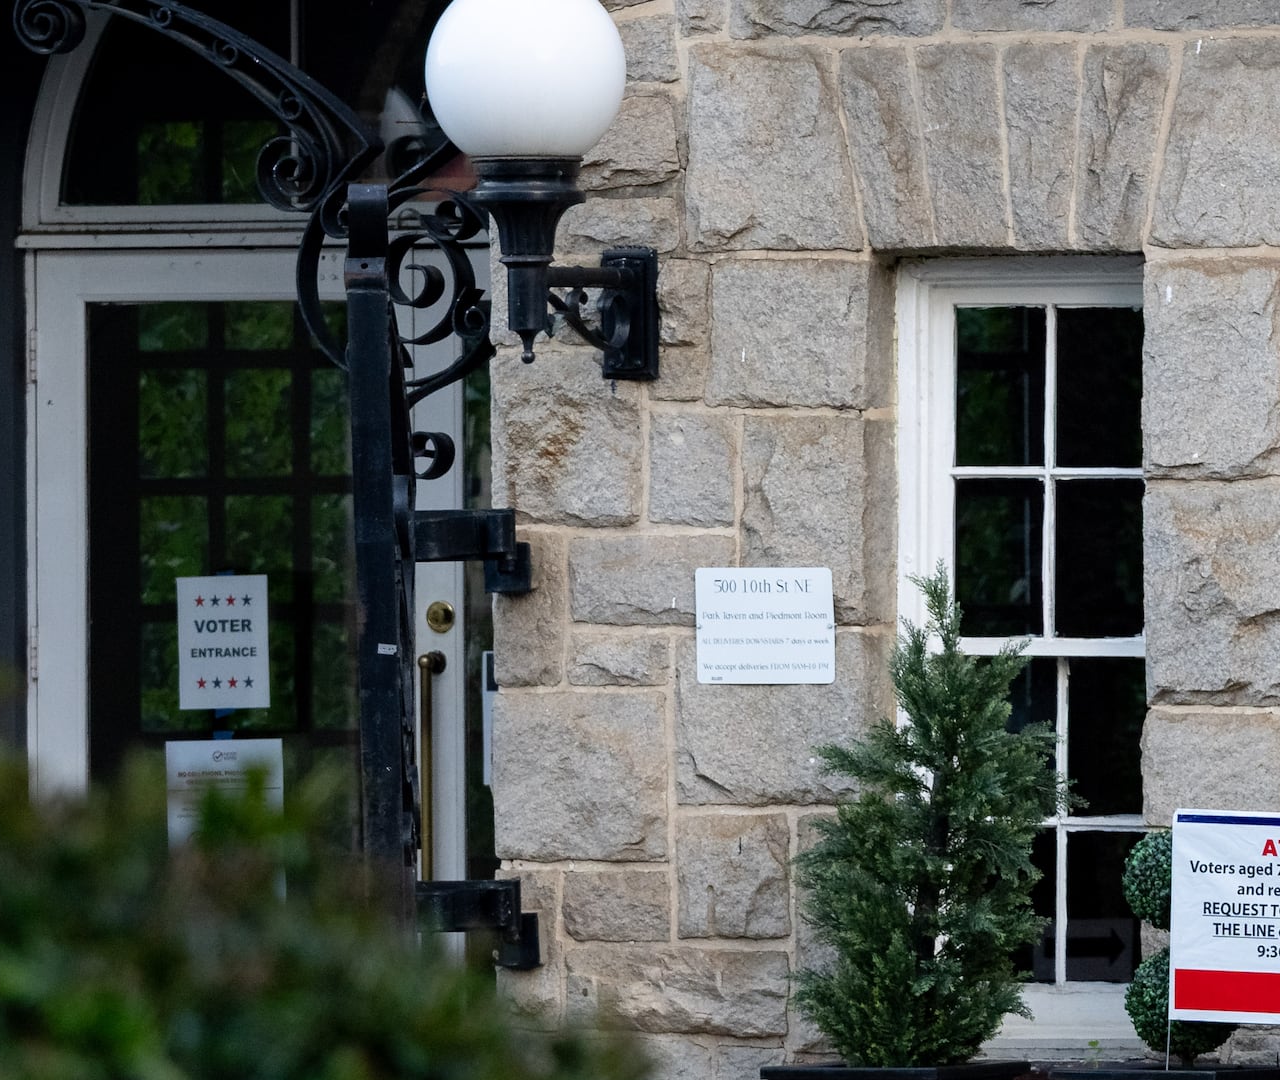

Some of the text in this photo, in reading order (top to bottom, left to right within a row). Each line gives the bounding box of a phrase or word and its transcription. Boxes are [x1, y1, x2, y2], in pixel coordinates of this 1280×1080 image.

[714, 579, 813, 593] 500 10th St NE
[702, 612, 720, 620] Park
[749, 612, 764, 620] and
[766, 612, 801, 620] Piedmont
[805, 612, 828, 620] Room
[194, 618, 253, 633] VOTER
[190, 647, 258, 658] ENTRANCE
[715, 664, 737, 672] accept
[1190, 860, 1236, 875] Voters
[1238, 863, 1274, 879] aged
[1237, 883, 1264, 896] and
[1203, 901, 1268, 917] REQUEST
[1213, 922, 1240, 936] THE
[1244, 923, 1275, 937] LINE
